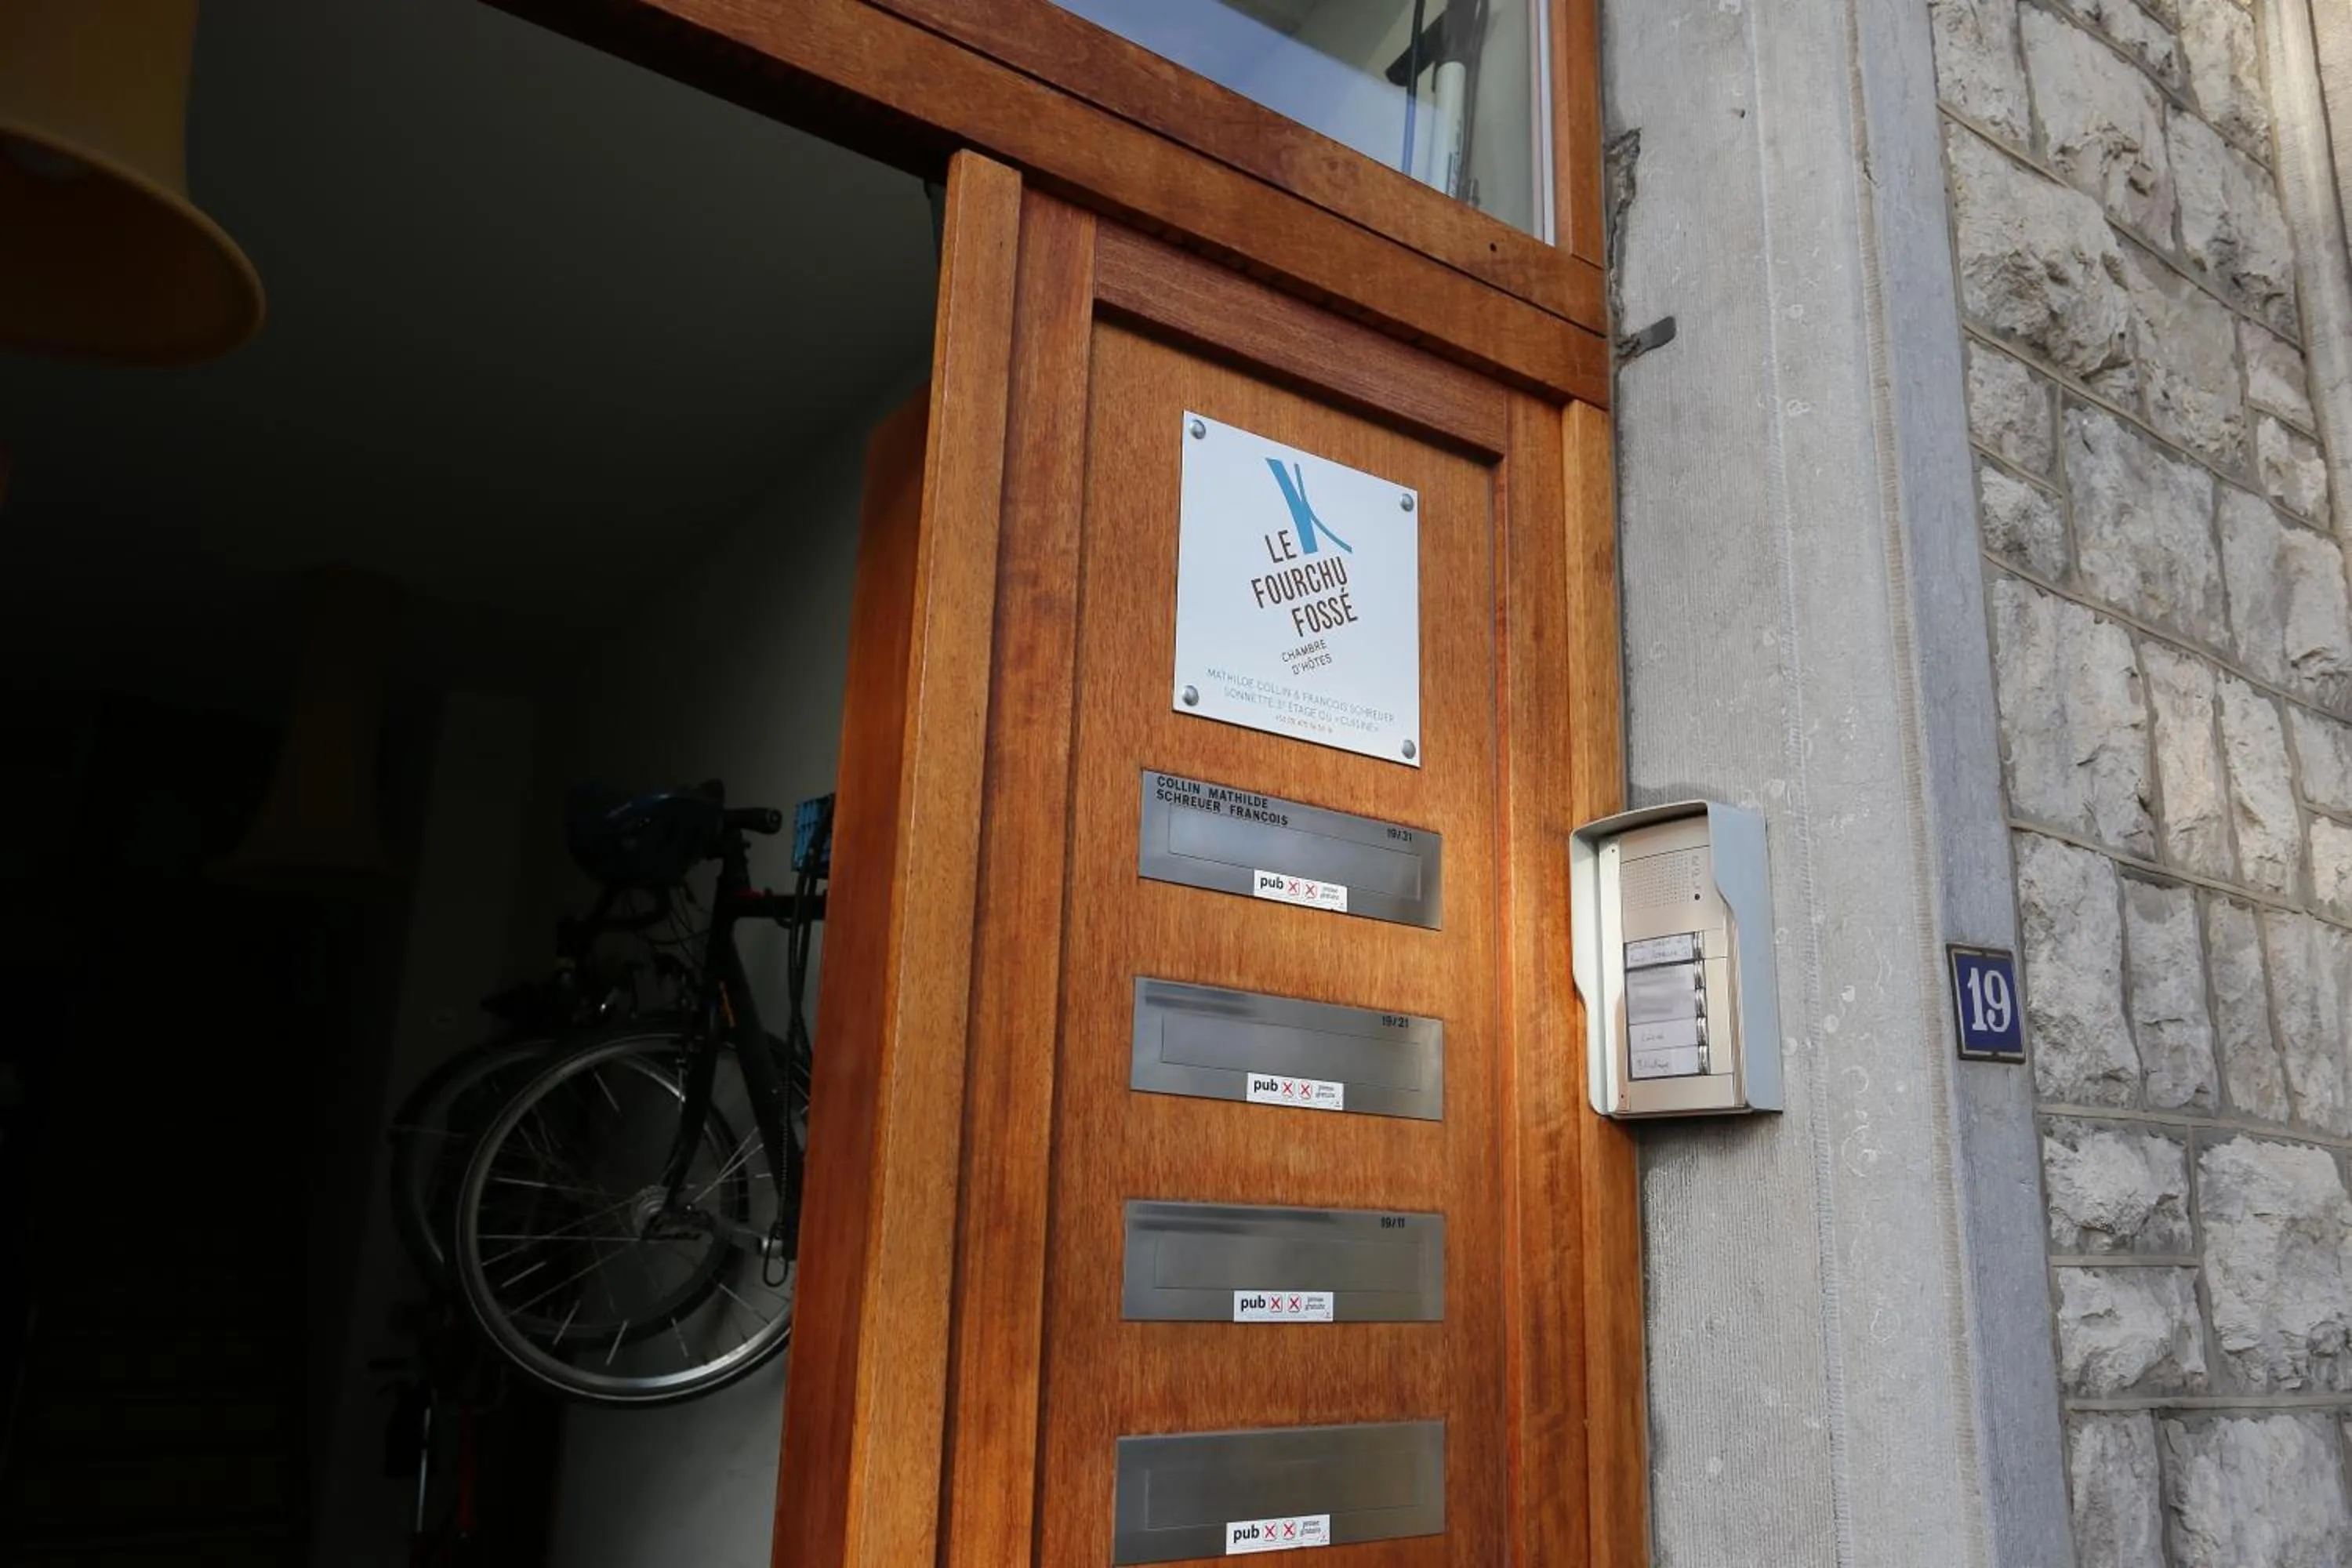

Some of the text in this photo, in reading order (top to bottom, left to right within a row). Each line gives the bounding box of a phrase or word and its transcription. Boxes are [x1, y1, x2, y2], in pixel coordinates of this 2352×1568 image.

[1264, 529, 1298, 564] LE
[1250, 556, 1348, 609] FOURCHU
[1291, 587, 1359, 637] FOSSÉ
[1281, 639, 1327, 662] CHAMBRE
[1207, 668, 1254, 688] MATHILDE
[1156, 775, 1269, 809] COLLIN MATHILDE
[1156, 789, 1221, 813] SCHREUER
[1259, 877, 1284, 890] pub
[1967, 967, 2012, 1033] 19
[1381, 1014, 1410, 1029] 19/21
[1254, 1079, 1279, 1093] pub
[1380, 1216, 1406, 1229] 19/11
[1240, 1294, 1267, 1312] pub
[1232, 1524, 1261, 1544] pub
